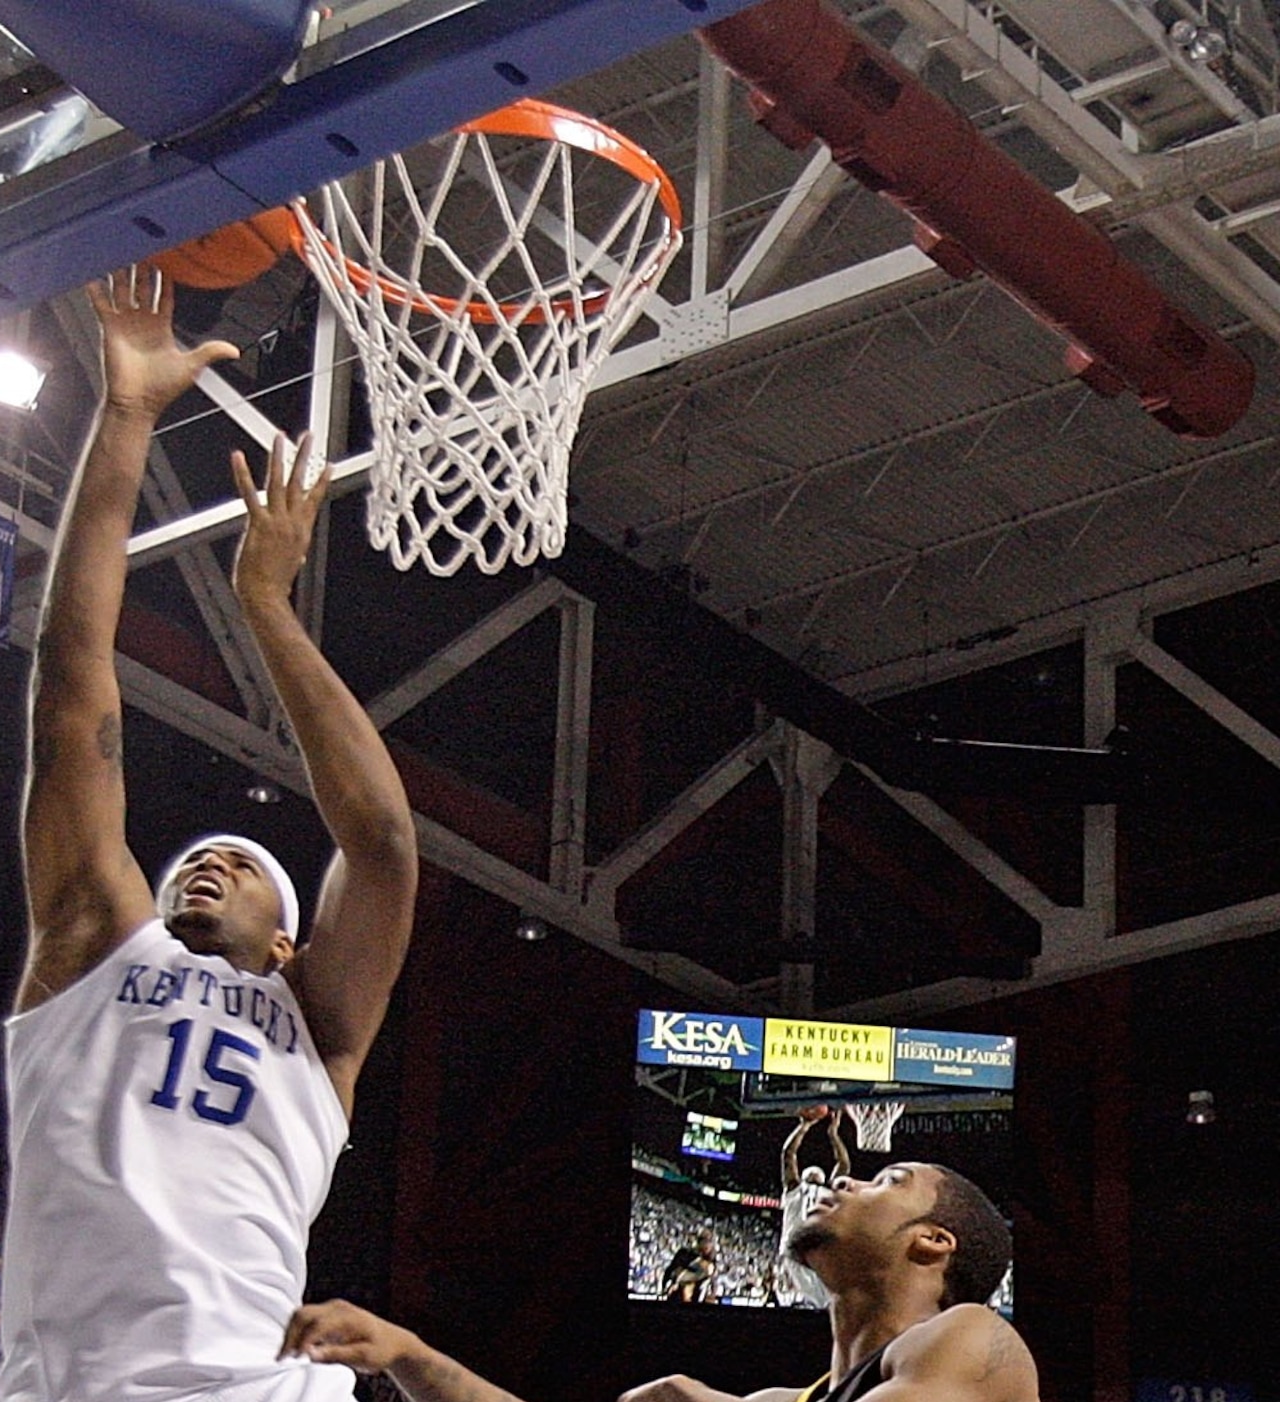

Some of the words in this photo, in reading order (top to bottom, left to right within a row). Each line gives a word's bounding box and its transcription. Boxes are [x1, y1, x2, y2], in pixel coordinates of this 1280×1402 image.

[650, 1010, 750, 1056] KESA
[784, 1023, 873, 1045] KENTUCKY
[667, 1050, 732, 1070] kesa.org
[771, 1042, 814, 1060] FARM
[821, 1045, 885, 1064] BUREAU
[150, 1017, 261, 1127] 15
